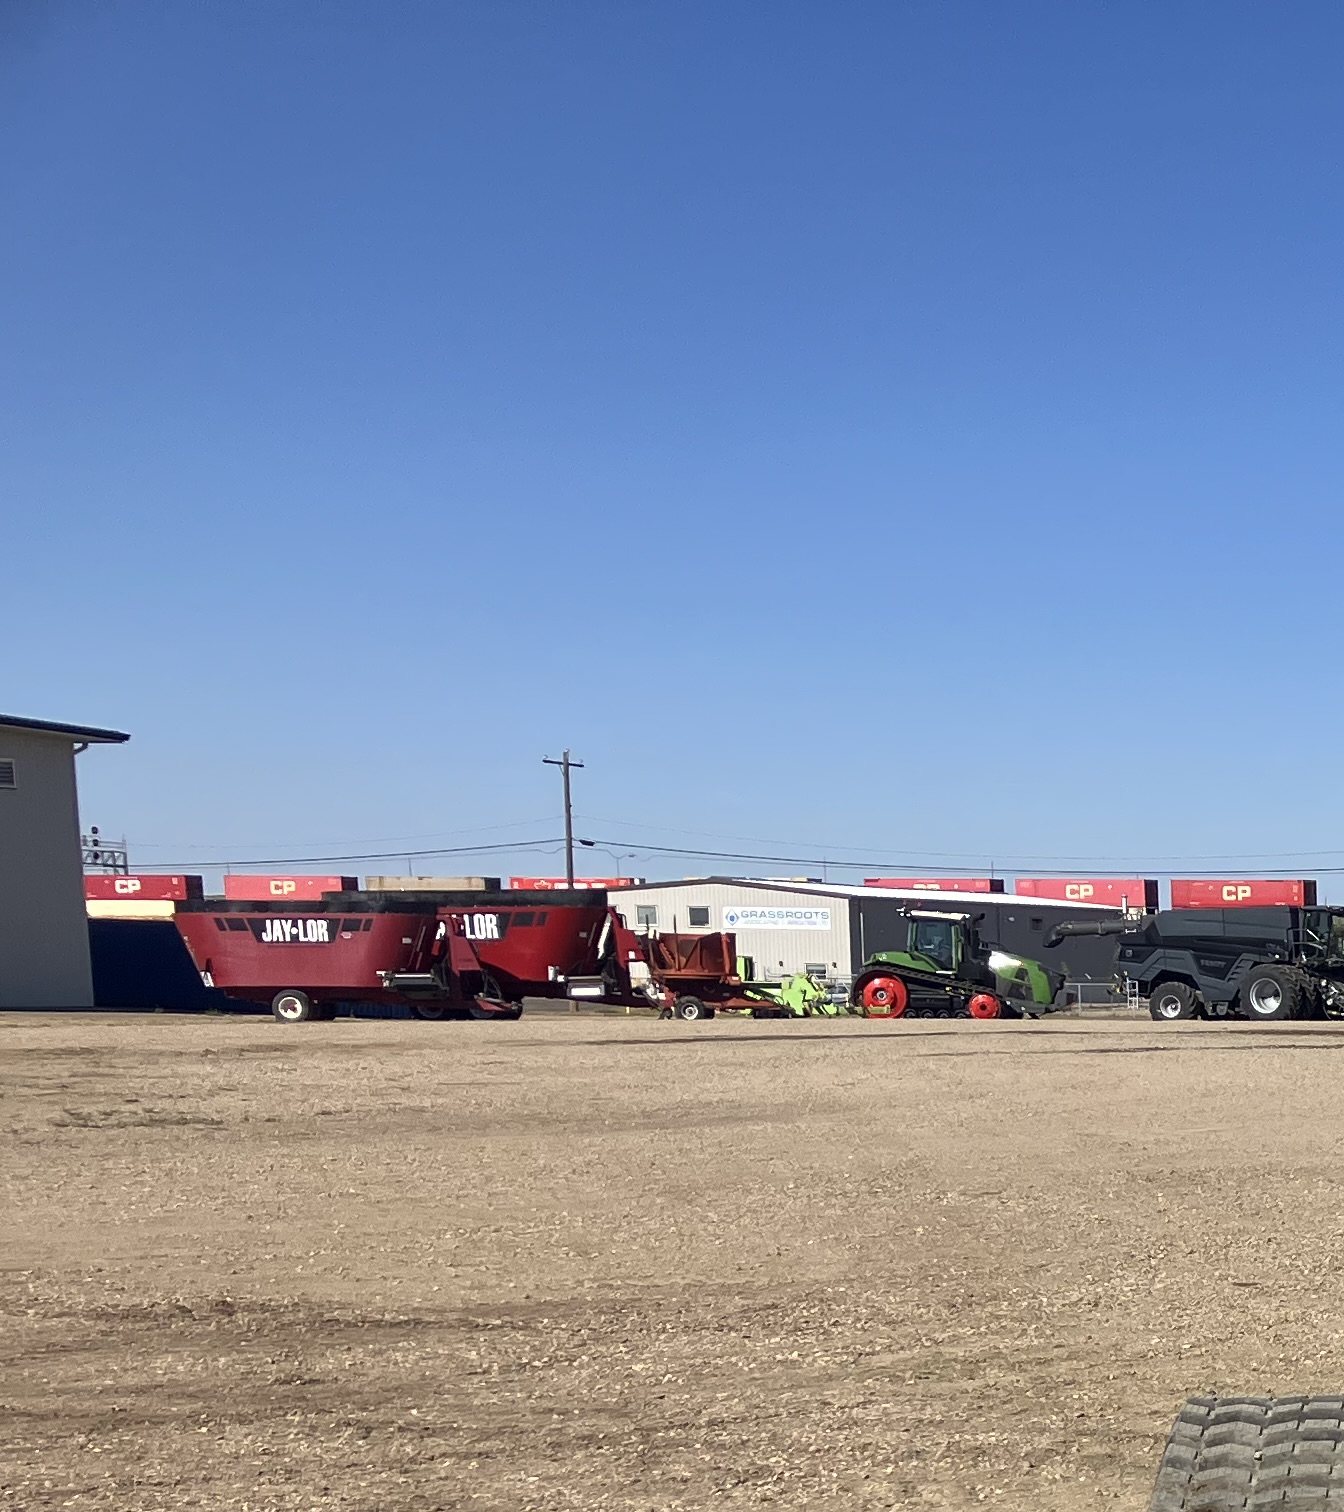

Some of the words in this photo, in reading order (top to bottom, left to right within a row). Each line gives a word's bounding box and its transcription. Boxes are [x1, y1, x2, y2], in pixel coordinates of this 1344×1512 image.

[114, 879, 141, 893] CP
[269, 880, 296, 895] CP
[1065, 884, 1094, 899] CP
[1222, 885, 1251, 901] CP
[740, 910, 829, 920] GRASSROOTS
